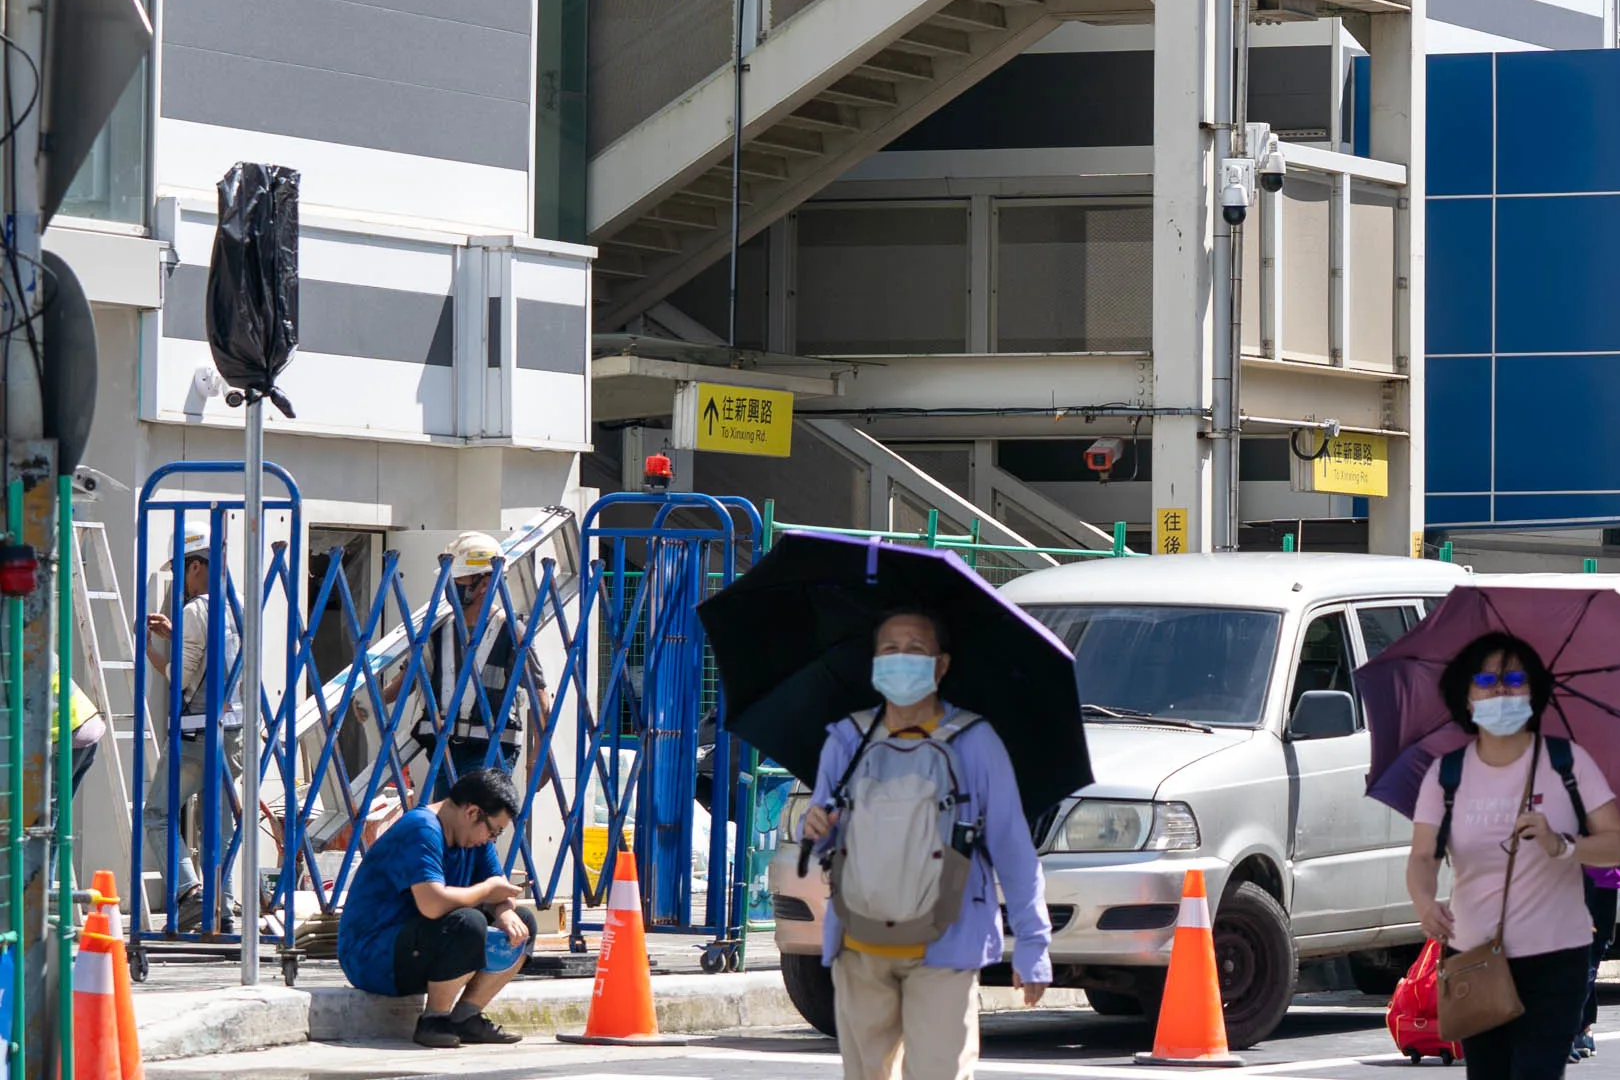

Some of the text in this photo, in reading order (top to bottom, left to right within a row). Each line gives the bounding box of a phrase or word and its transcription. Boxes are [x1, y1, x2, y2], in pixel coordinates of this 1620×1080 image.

[722, 395, 773, 425] 往新興路
[721, 426, 768, 444] To Xinxing Rd.
[1334, 442, 1373, 466] 往新興路
